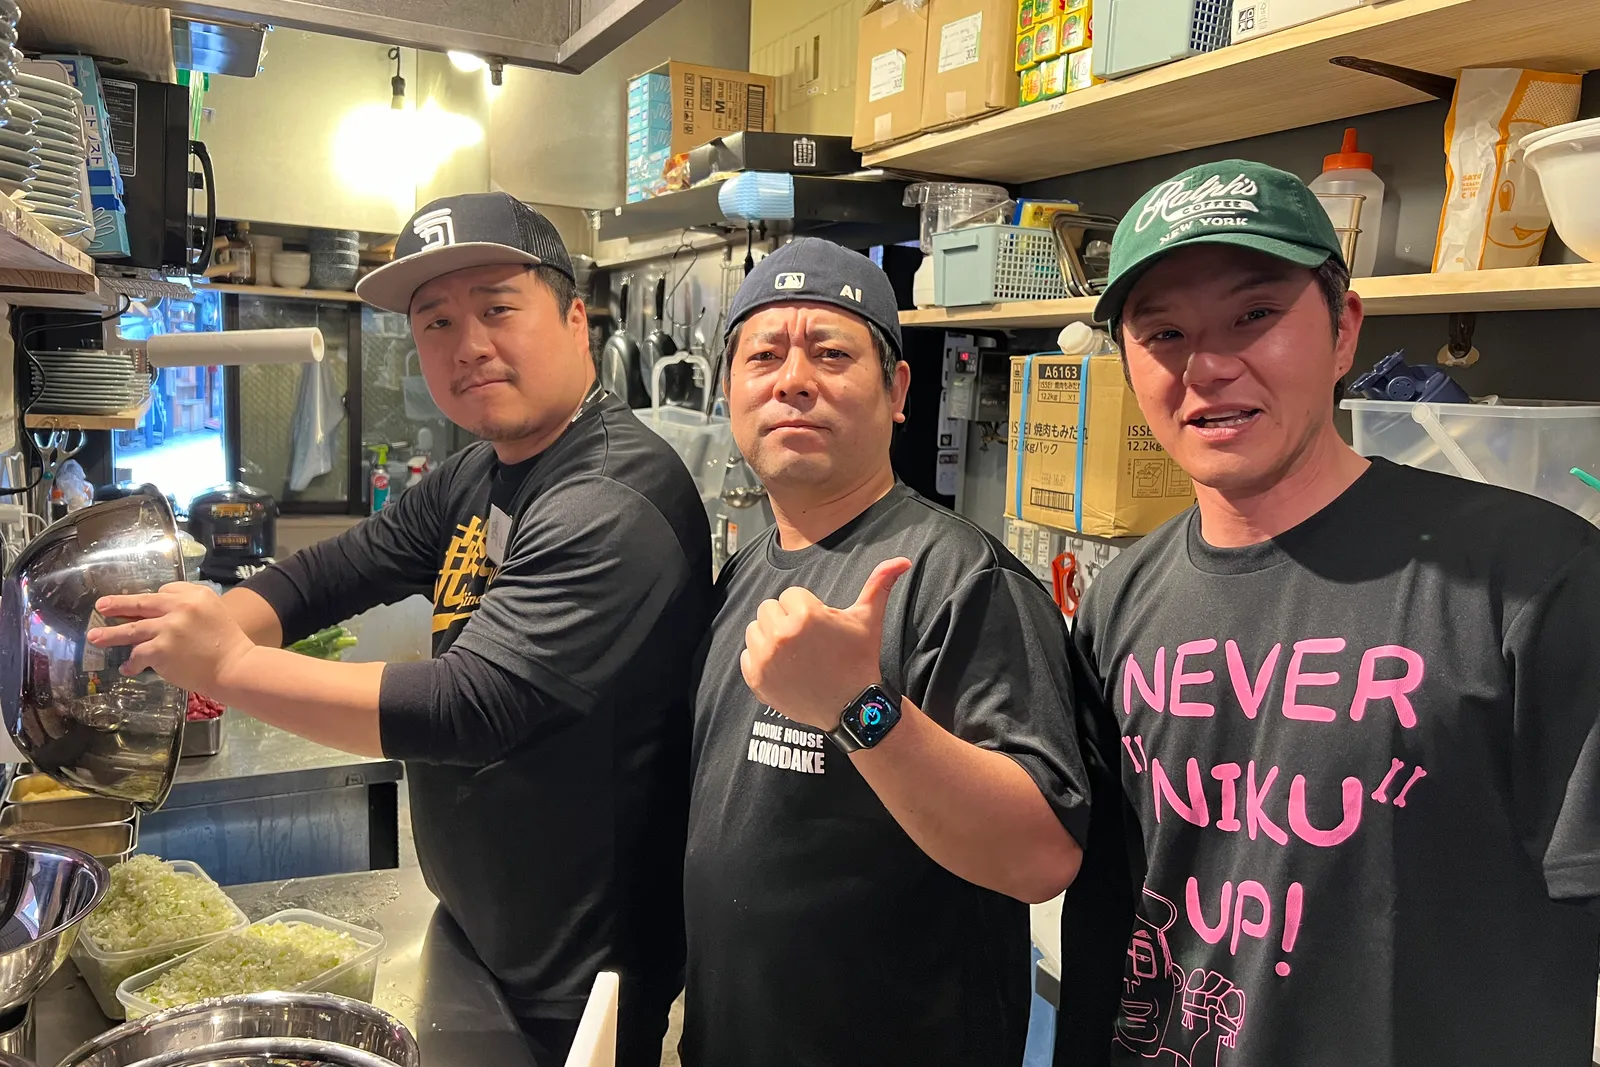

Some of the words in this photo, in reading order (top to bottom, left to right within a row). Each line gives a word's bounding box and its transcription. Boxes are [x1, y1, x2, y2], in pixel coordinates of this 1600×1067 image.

[1134, 173, 1258, 233] Ralph's
[1181, 200, 1242, 215] COFFEE
[1159, 220, 1194, 246] NEW
[1199, 217, 1249, 227] YORK
[840, 284, 862, 303] AI
[1044, 366, 1078, 379] A6163
[1011, 420, 1031, 435] ISEI
[1123, 637, 1425, 729] NEVER
[752, 720, 783, 741] NOODLE
[783, 727, 824, 749] HOUSE
[747, 738, 825, 775] KOKODAKE
[1185, 876, 1304, 977] UP!
